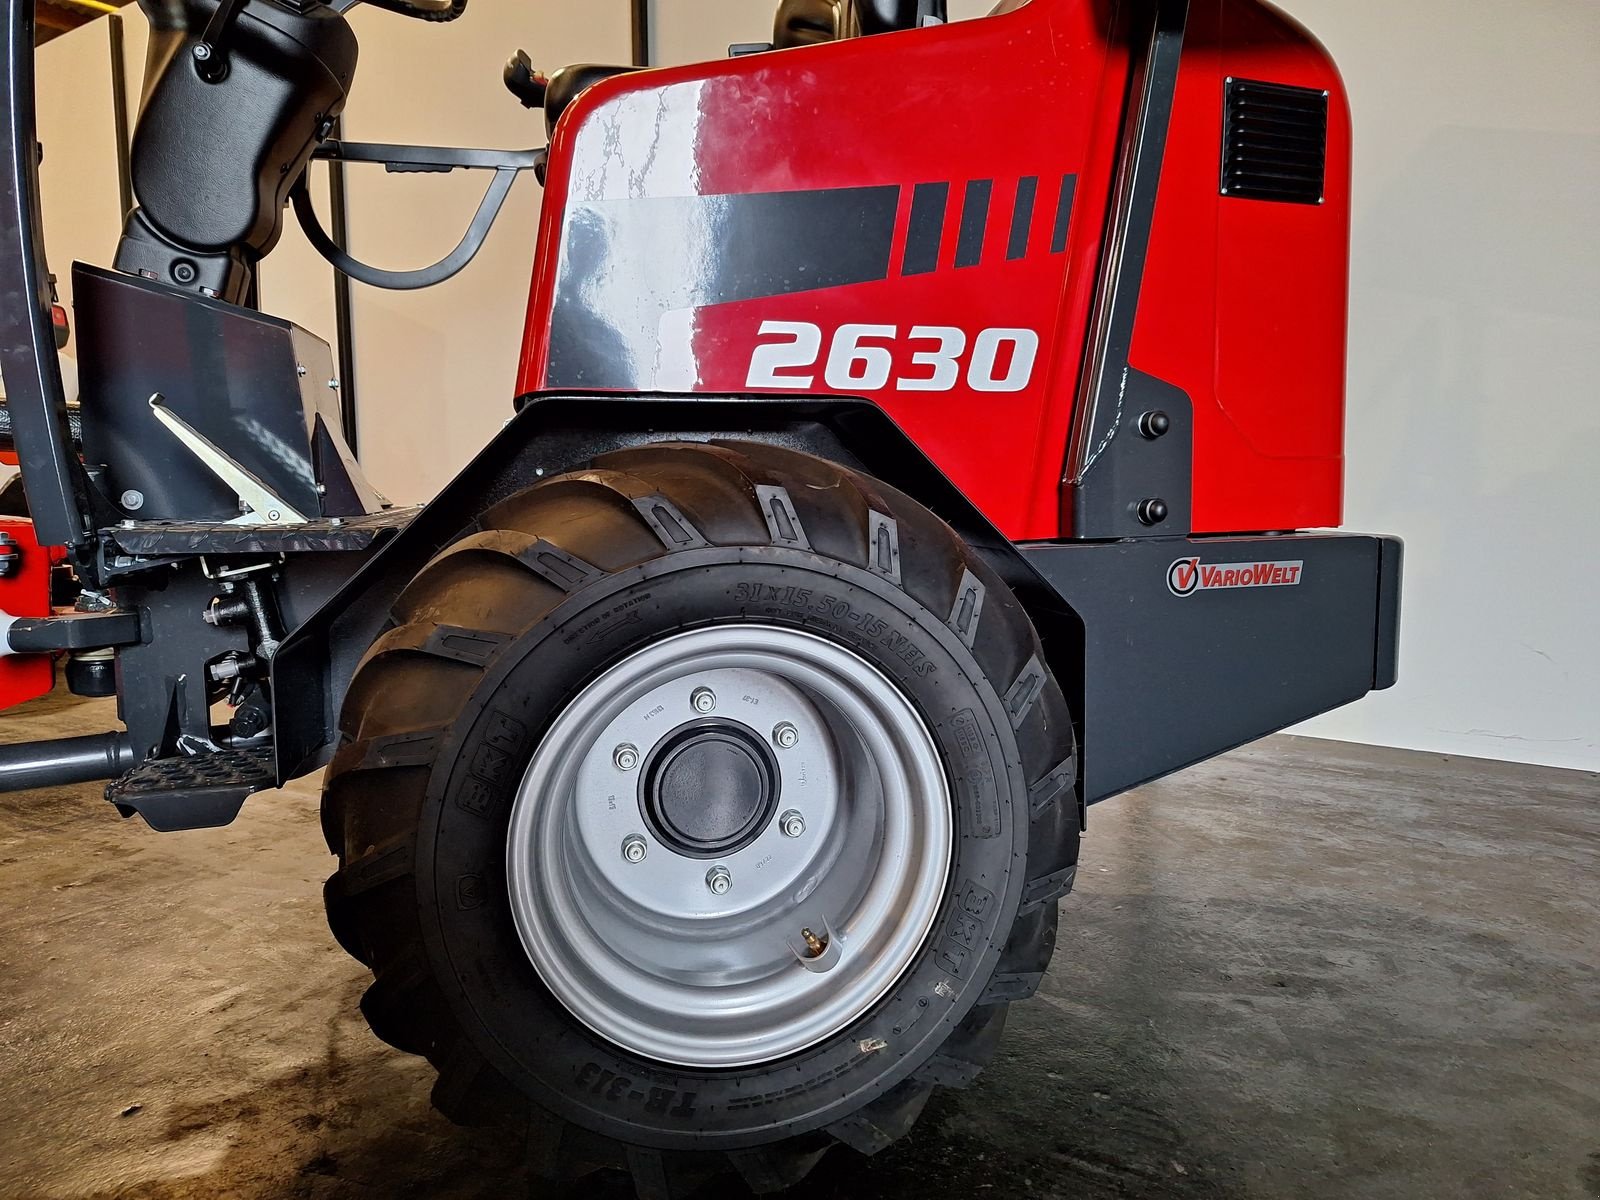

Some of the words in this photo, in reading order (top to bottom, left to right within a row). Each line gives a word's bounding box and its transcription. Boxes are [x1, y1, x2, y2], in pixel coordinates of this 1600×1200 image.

[745, 320, 1039, 392] 2630
[1201, 564, 1299, 587] VARIOWELT
[460, 716, 522, 815] BKT
[942, 884, 991, 976] BKT
[574, 1062, 697, 1118] TR-313
